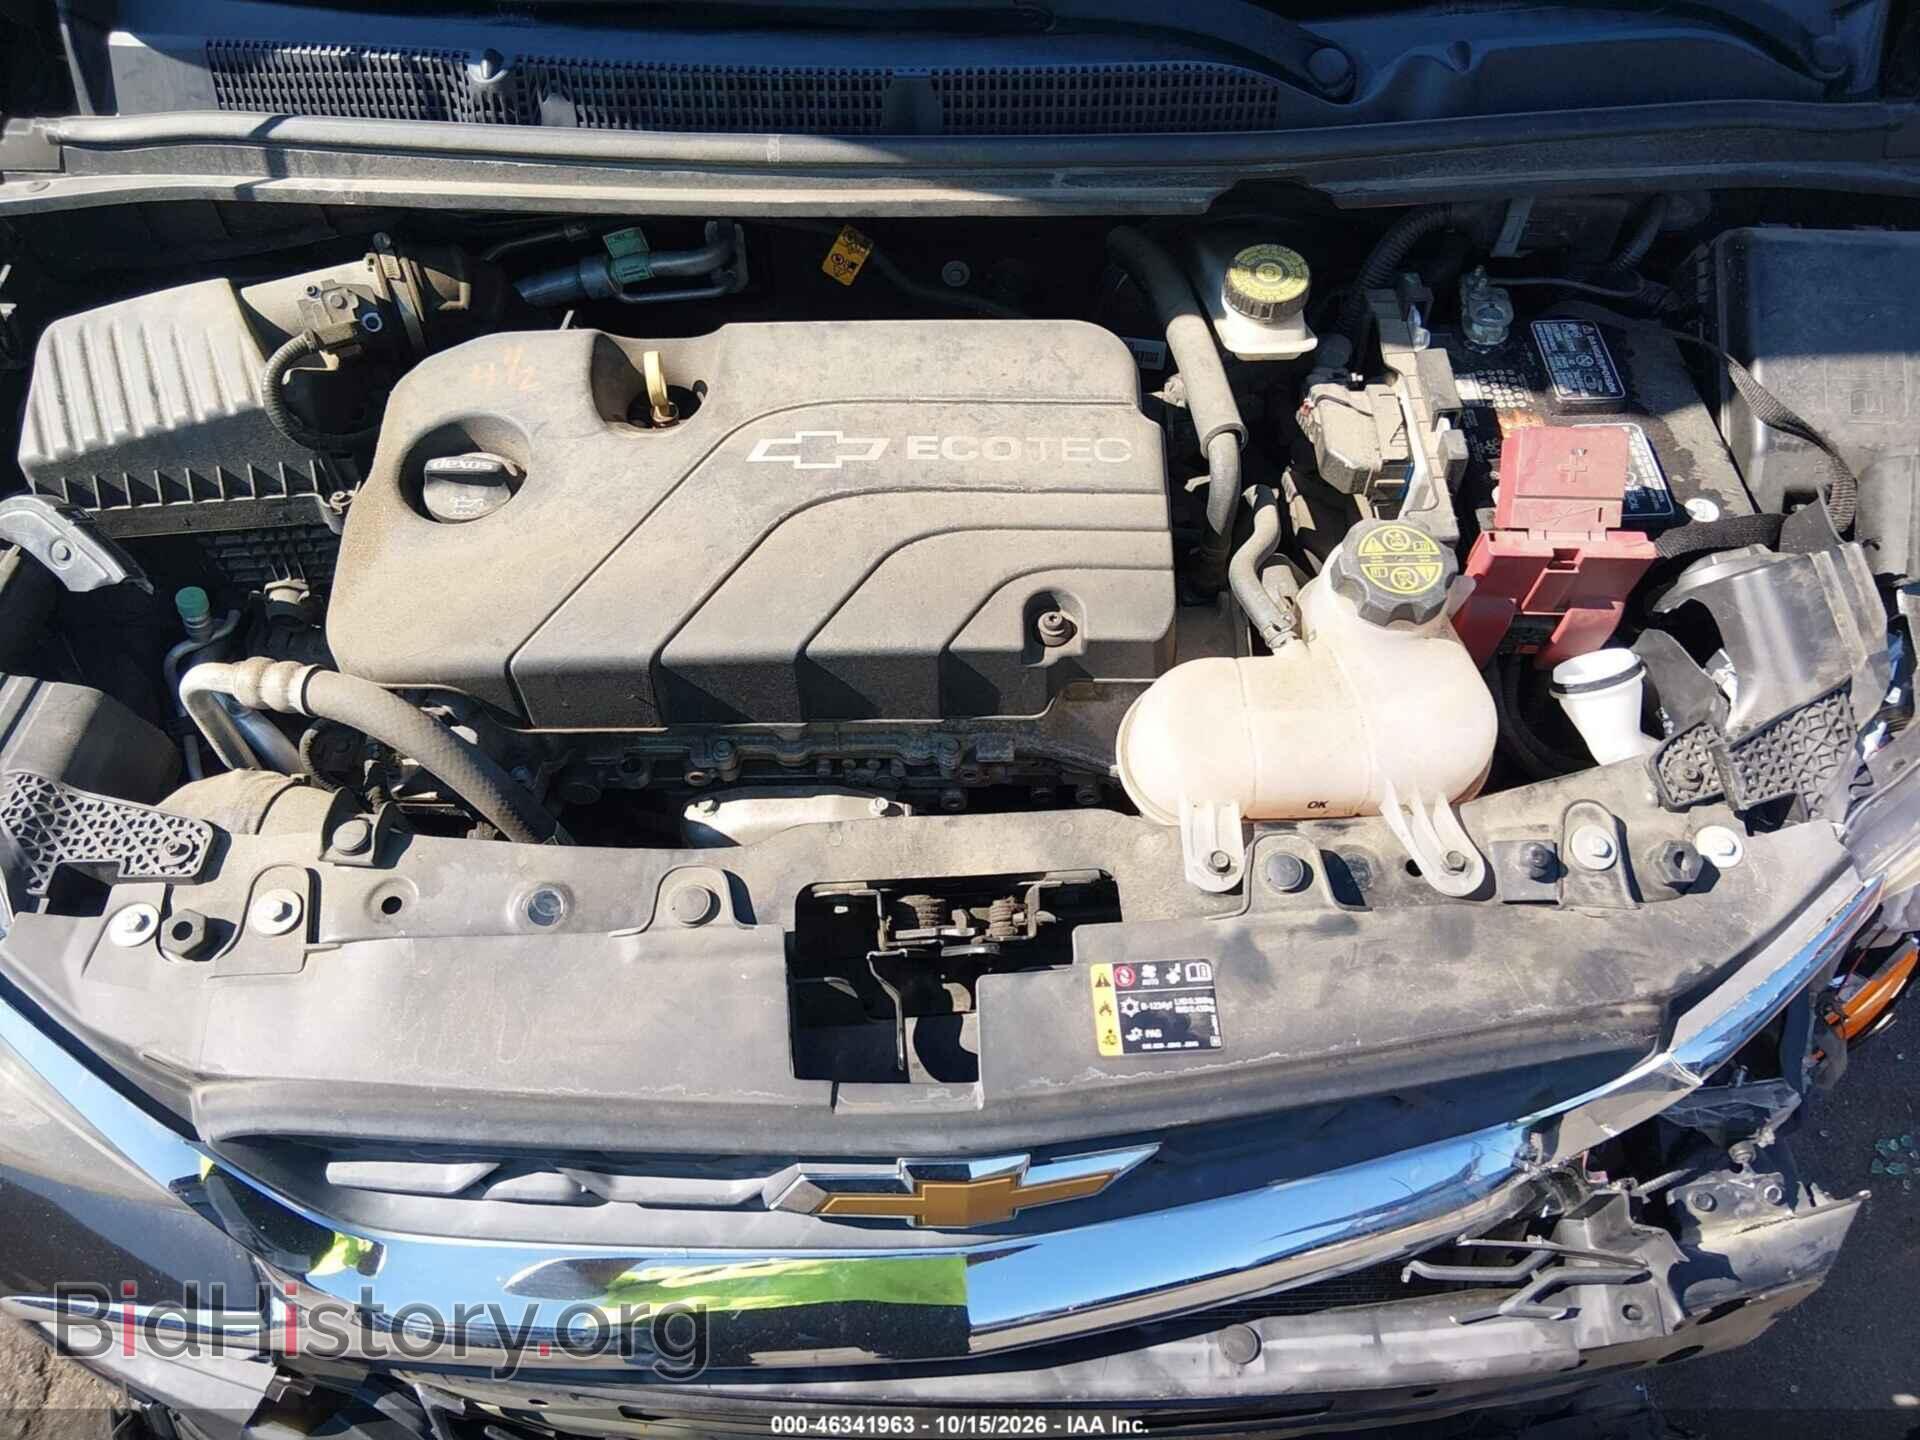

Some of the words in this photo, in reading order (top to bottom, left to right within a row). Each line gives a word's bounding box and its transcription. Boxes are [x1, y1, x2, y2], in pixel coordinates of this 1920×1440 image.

[907, 435, 1132, 463] ECOTEC
[430, 458, 494, 470] dexos
[1307, 800, 1329, 809] OK
